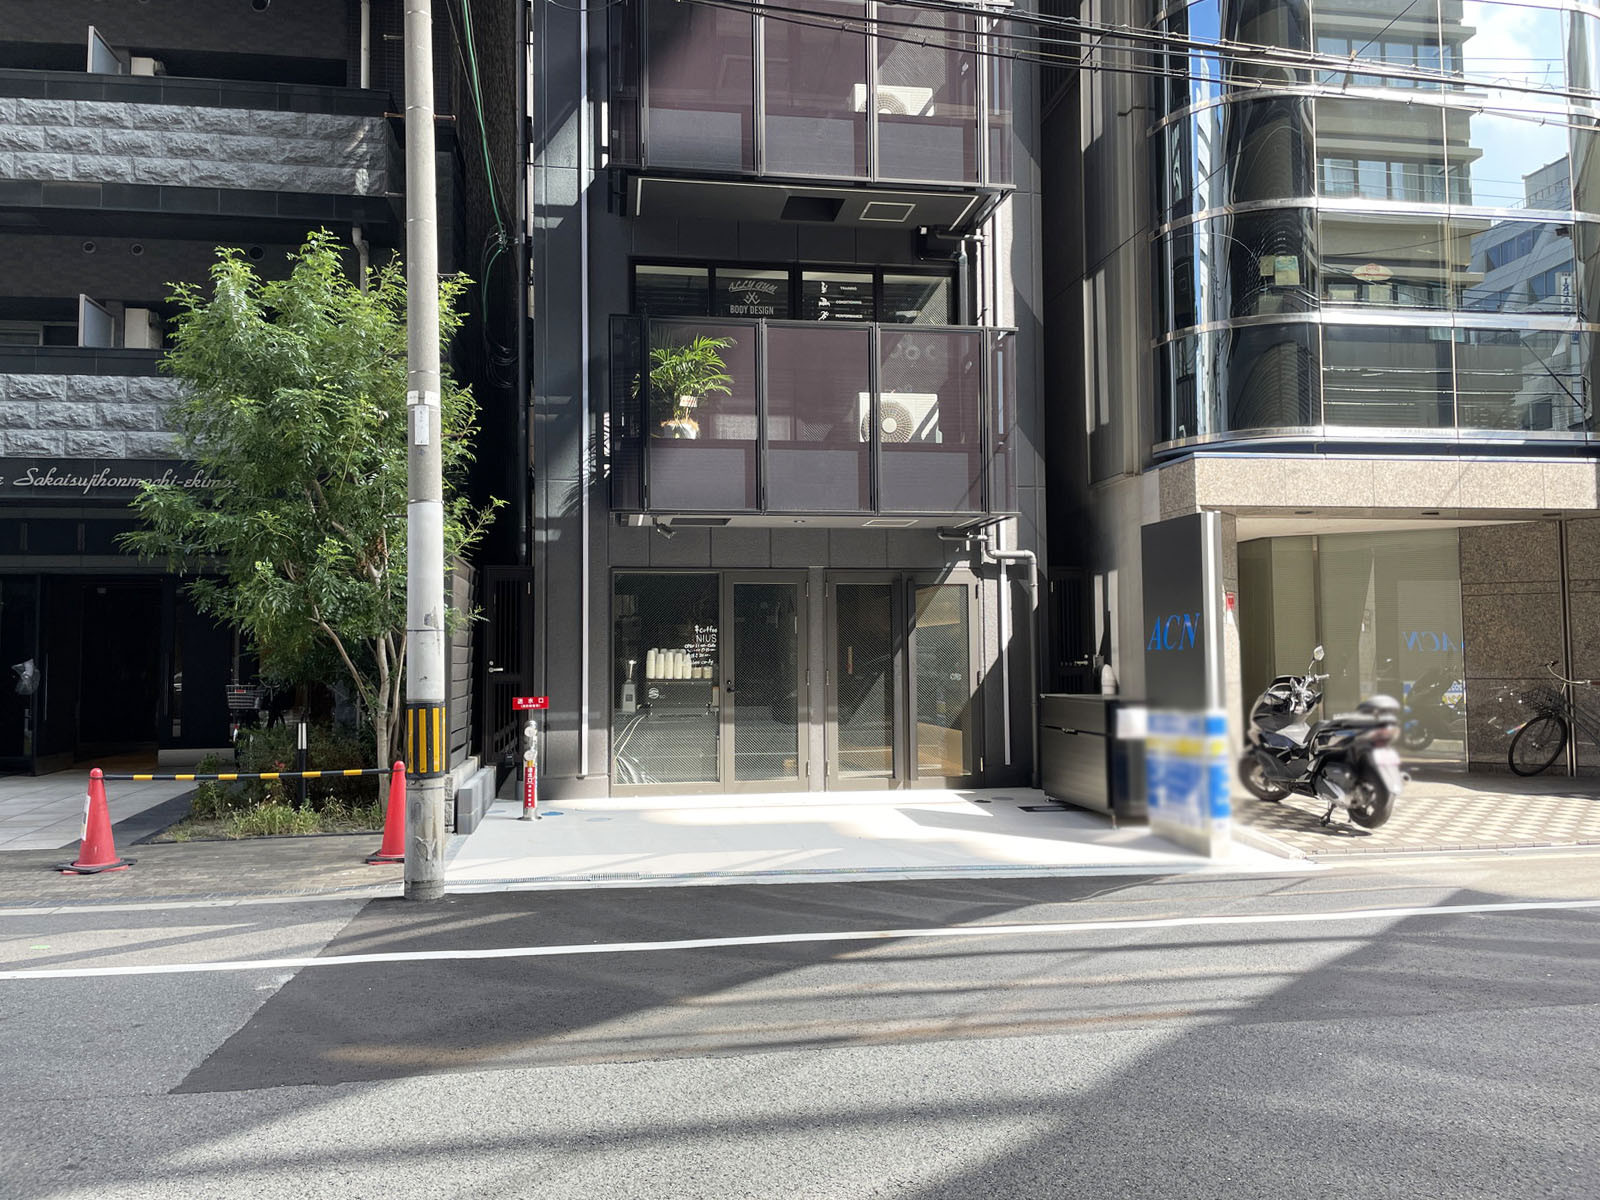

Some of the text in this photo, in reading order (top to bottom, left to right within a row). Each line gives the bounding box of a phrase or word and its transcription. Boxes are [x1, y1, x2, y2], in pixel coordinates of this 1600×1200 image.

[730, 304, 774, 315] BODY DESIGN
[1146, 612, 1200, 651] ACN
[696, 634, 717, 643] NIUS
